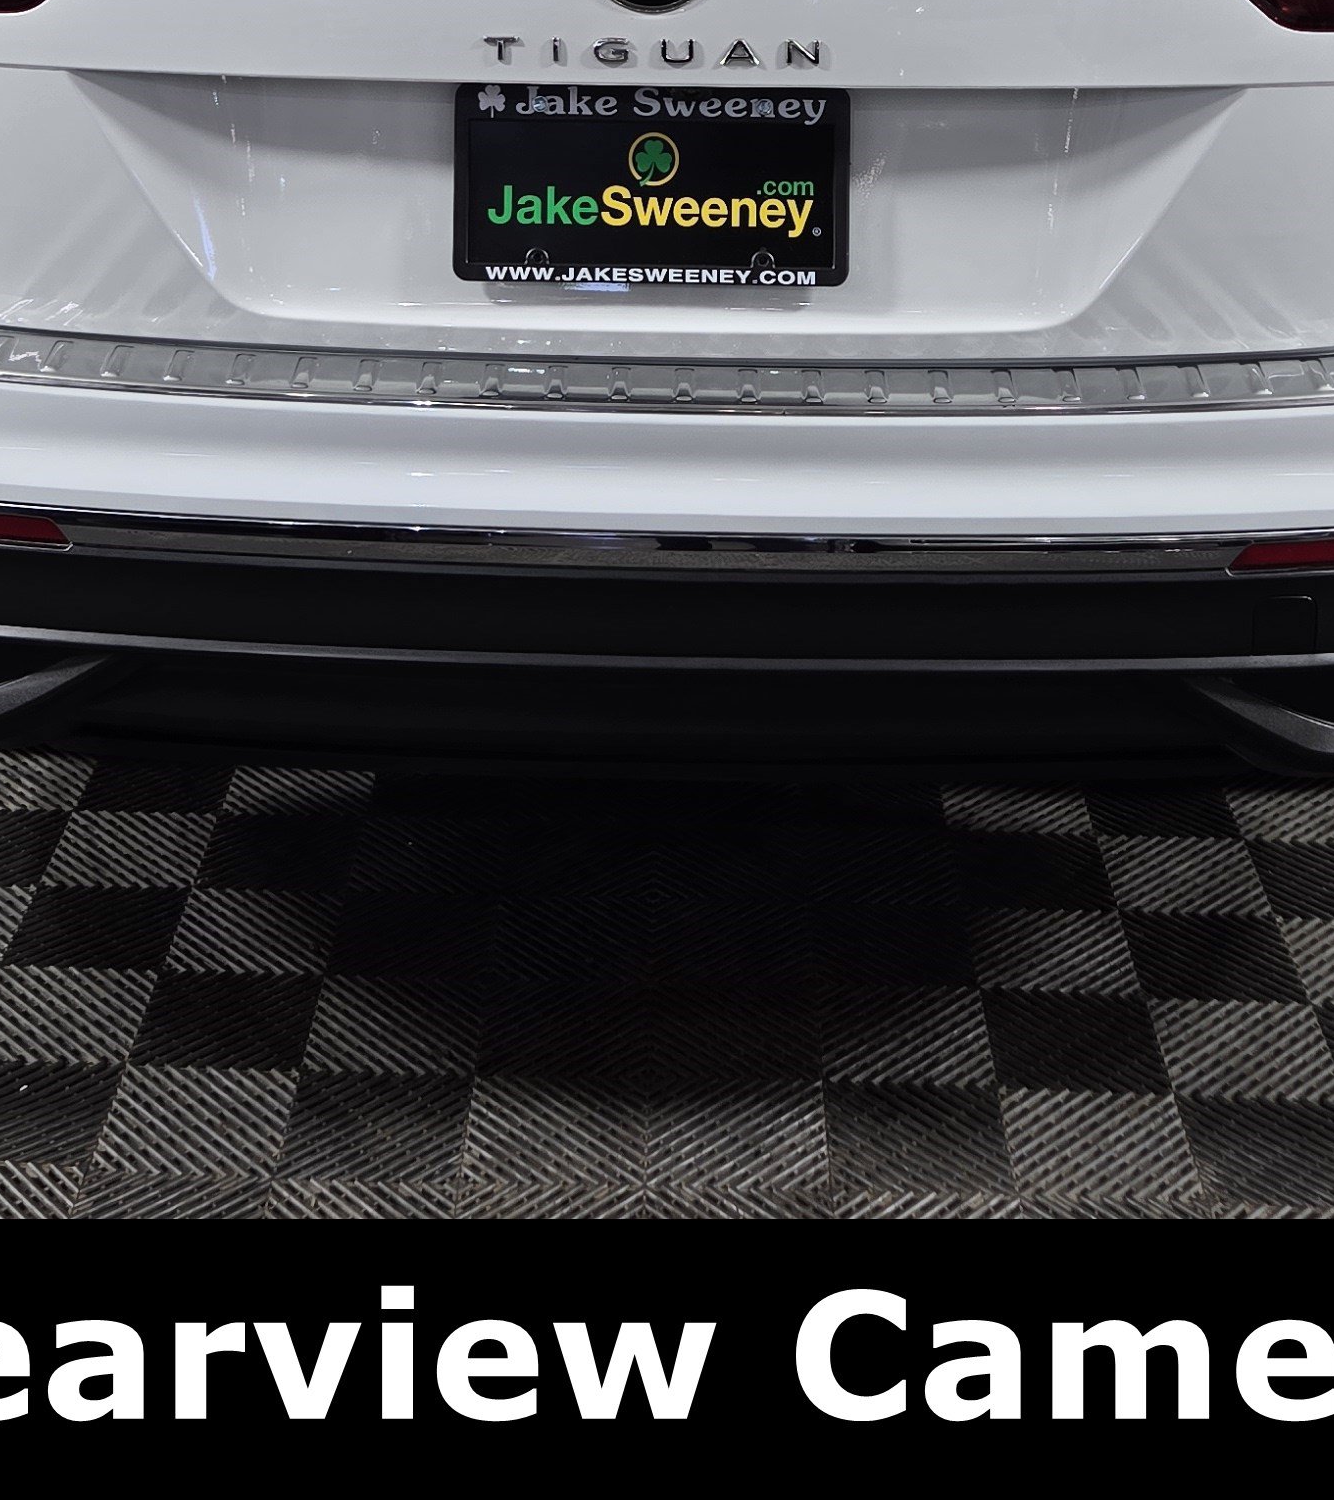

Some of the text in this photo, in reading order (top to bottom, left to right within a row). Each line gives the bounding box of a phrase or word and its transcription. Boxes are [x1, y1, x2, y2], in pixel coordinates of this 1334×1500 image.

[483, 36, 821, 67] TIGUAN
[515, 86, 827, 125] Jake Sweeney
[757, 180, 814, 197] .com
[485, 266, 816, 286] WWW.JAKESWEENEY.COM
